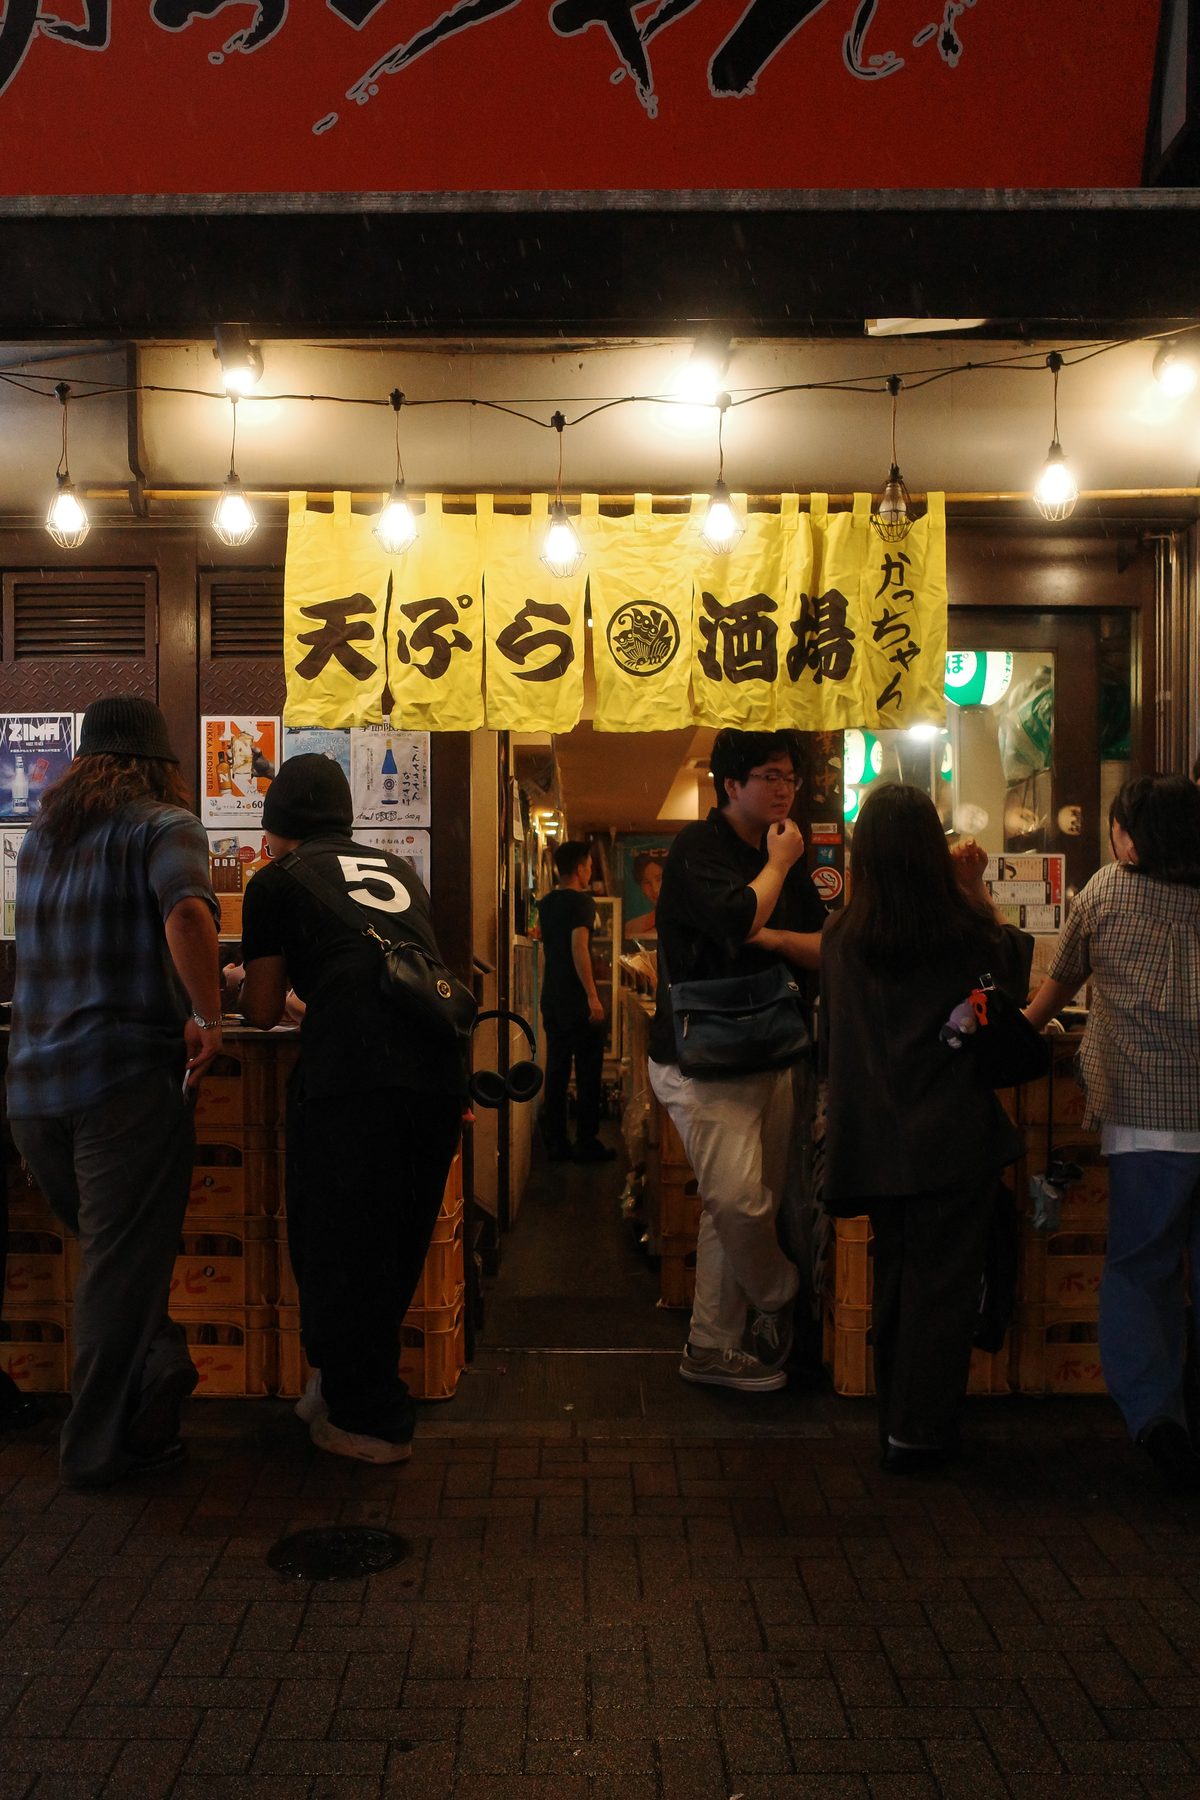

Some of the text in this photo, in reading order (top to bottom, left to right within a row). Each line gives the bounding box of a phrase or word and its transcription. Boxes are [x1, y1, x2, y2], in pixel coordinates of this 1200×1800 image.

[294, 588, 857, 686] 天ぷら 酒場
[872, 552, 922, 712] かっちゃん
[8, 723, 60, 742] ZIMA
[252, 800, 263, 809] 60
[337, 855, 411, 914] 5
